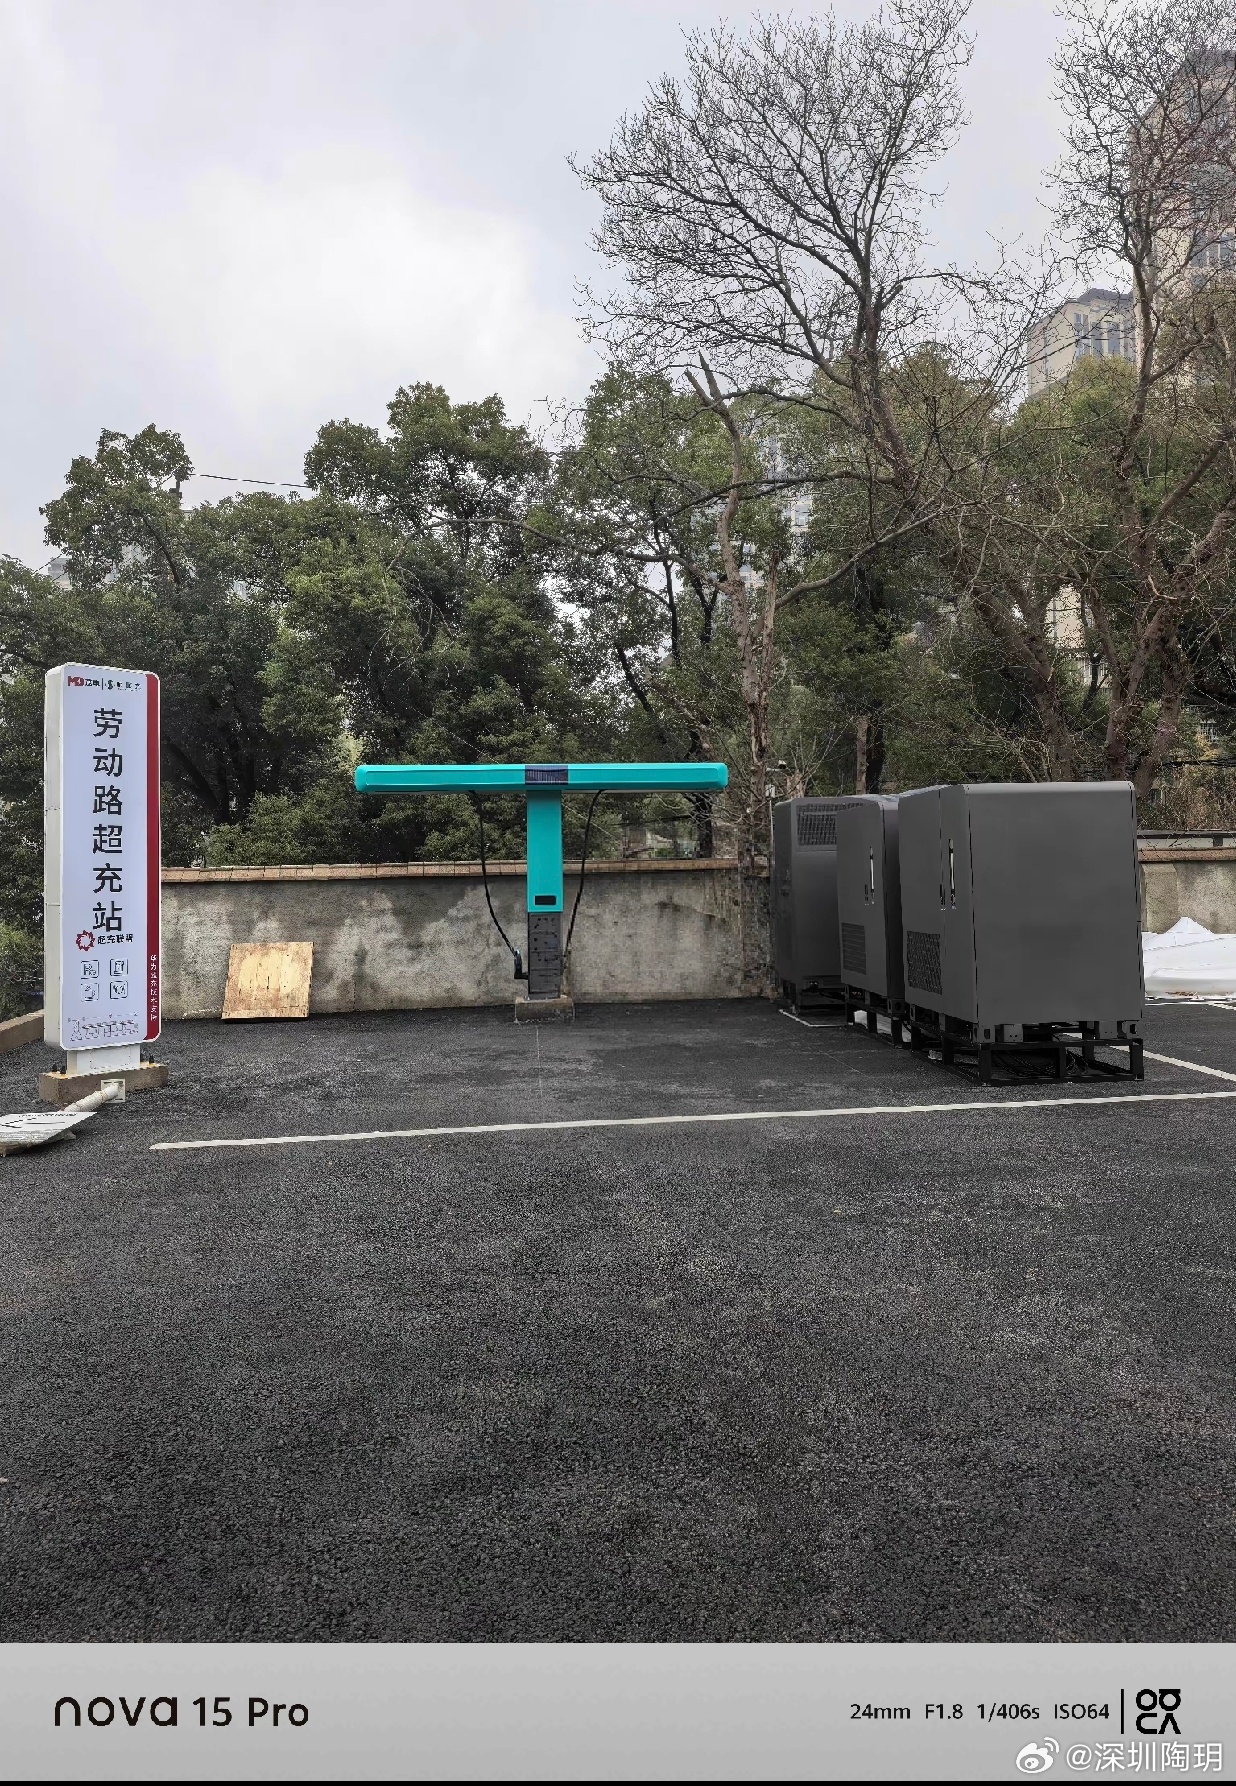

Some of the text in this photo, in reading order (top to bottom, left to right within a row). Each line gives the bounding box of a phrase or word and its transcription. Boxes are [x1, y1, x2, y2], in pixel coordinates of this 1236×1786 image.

[92, 707, 123, 932] 劳动路超充站
